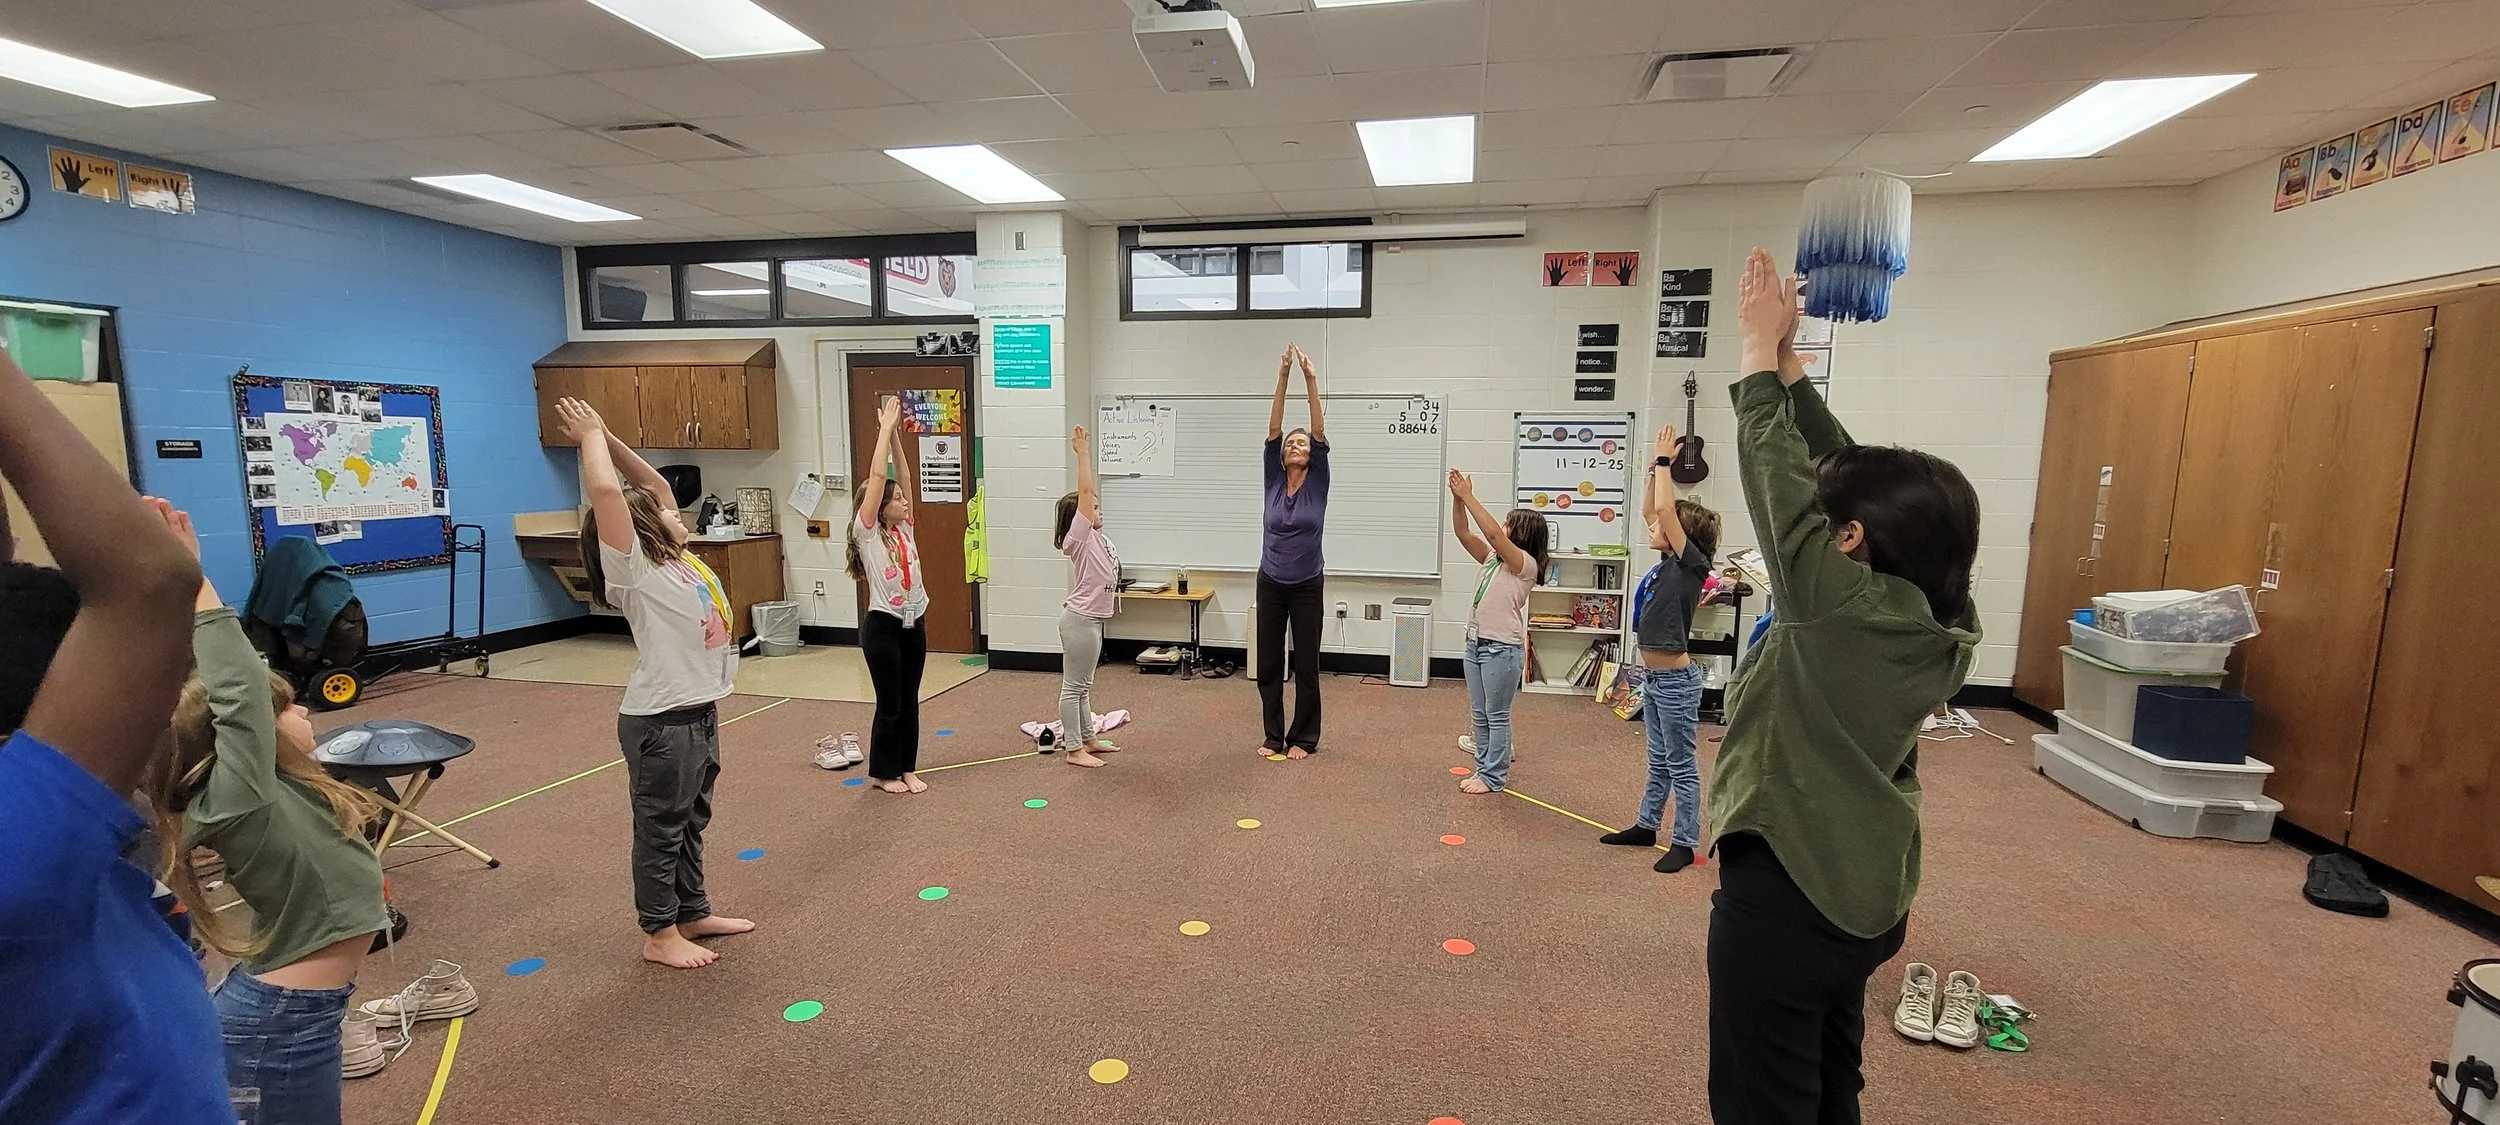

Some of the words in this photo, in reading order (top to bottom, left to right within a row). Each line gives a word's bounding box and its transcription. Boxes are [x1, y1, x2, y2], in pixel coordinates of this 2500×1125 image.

[2402, 113, 2424, 133] Dd
[2320, 145, 2337, 161] Bb
[88, 163, 114, 177] Left
[130, 172, 160, 187] Right
[10, 185, 20, 195] 3
[1567, 258, 1586, 267] Left
[1595, 259, 1617, 269] Right
[1663, 273, 1675, 282] Be
[1662, 283, 1682, 291] Kind
[1661, 303, 1672, 312] Be
[1658, 334, 1670, 343] Be
[1657, 344, 1688, 352] Musical
[914, 402, 947, 411] EVERYONE
[915, 413, 947, 421] WELCOME
[1102, 432, 1137, 440] Instruments
